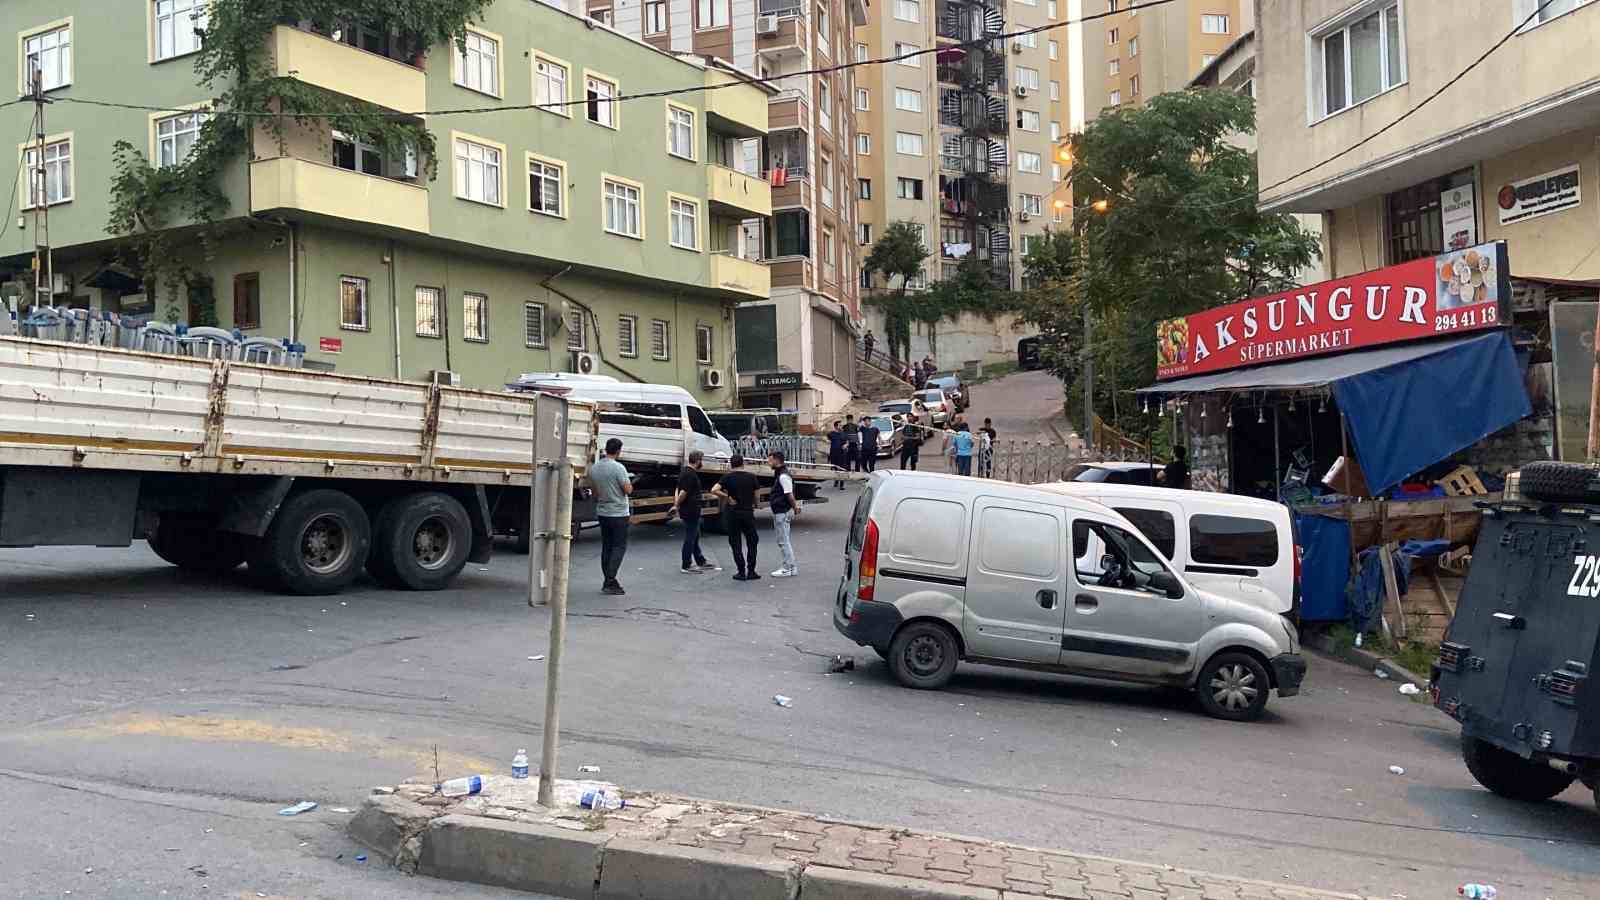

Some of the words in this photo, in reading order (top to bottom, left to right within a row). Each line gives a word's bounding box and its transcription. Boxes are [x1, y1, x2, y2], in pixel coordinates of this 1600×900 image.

[1193, 285, 1427, 364] AKSUNGUR
[1435, 313, 1457, 331] 294
[1460, 310, 1476, 327] 41
[1481, 306, 1496, 323] 13
[1240, 328, 1353, 362] SÜPERMARKET
